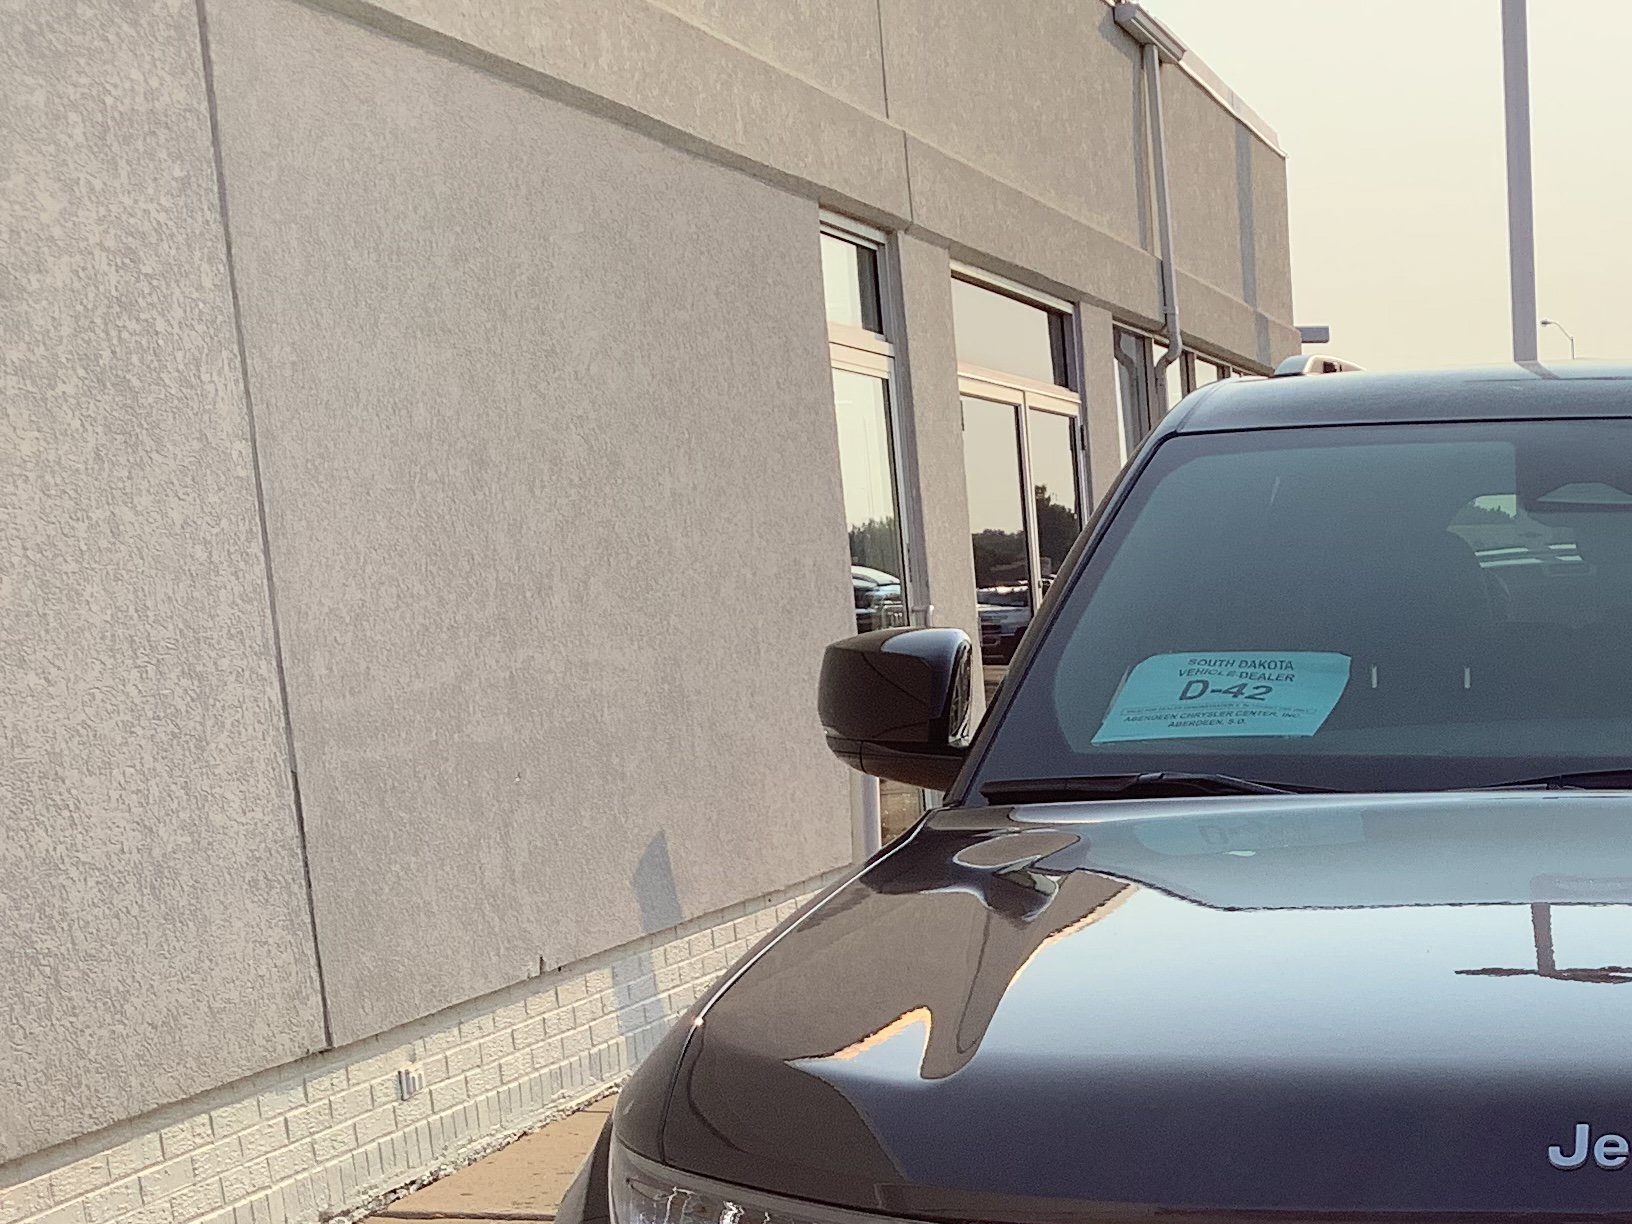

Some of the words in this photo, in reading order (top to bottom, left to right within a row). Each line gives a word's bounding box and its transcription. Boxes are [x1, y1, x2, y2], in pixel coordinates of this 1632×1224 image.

[1187, 658, 1236, 668] SOUTH
[1238, 659, 1294, 671] DAKOTA
[1178, 668, 1237, 678] VEHICLE
[1239, 671, 1295, 682] DEALER
[1178, 679, 1273, 701] D-42
[1179, 710, 1235, 719] CHRYSLER
